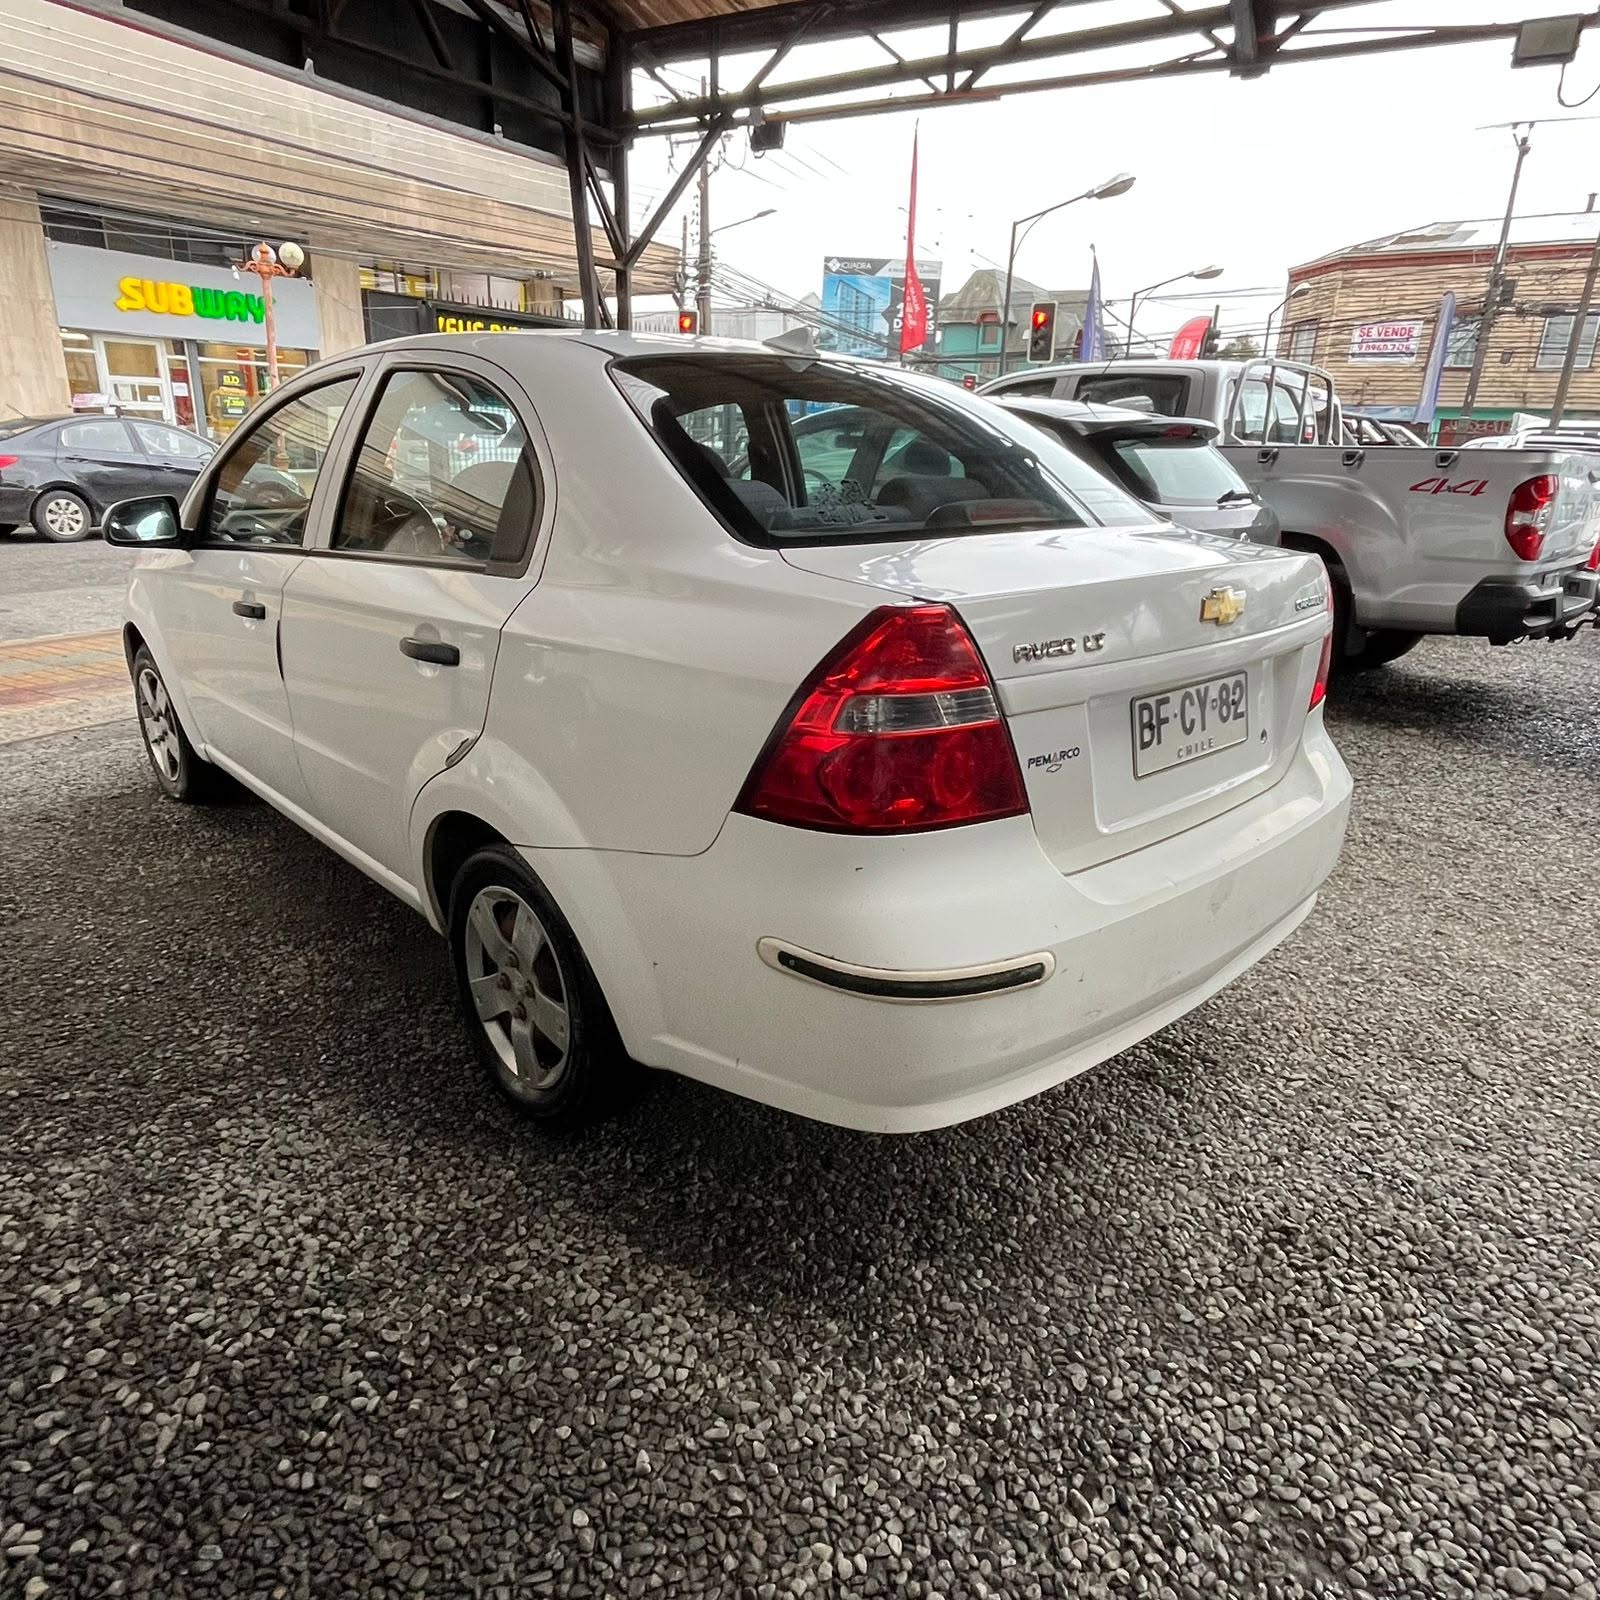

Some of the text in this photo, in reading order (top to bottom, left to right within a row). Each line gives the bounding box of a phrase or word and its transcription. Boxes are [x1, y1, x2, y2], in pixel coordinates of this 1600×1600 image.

[115, 276, 276, 325] SUBWAY
[1360, 326, 1415, 338] SE VENDE
[1409, 478, 1489, 496] 4x4
[1028, 747, 1080, 769] PEMARCO
[1176, 737, 1215, 759] CHILE
